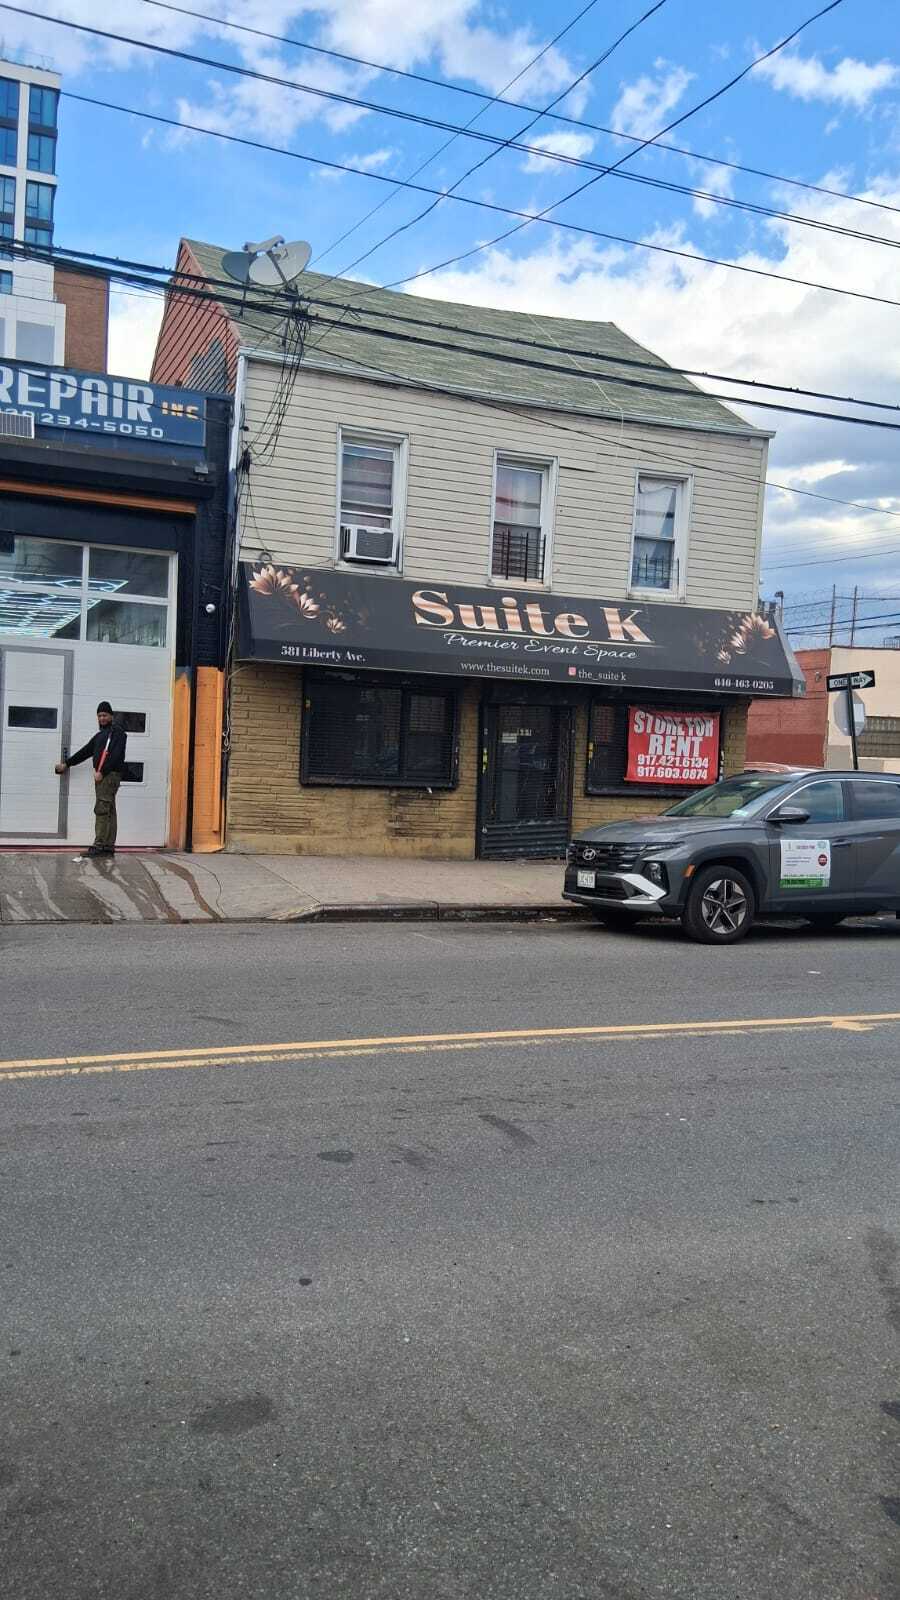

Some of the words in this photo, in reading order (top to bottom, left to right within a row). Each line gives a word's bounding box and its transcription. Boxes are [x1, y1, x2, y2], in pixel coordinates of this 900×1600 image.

[162, 401, 200, 421] INC
[411, 589, 590, 638] Suite
[600, 607, 656, 643] K
[281, 645, 300, 657] 581
[302, 647, 341, 662] Liberty
[345, 650, 366, 662] Ave.
[443, 633, 519, 651] Premier
[524, 639, 578, 655] Event
[583, 645, 639, 662] Space
[460, 661, 550, 676] www.thesuitek.com
[833, 678, 848, 687] ONE
[853, 676, 867, 684] WAY
[633, 710, 685, 736] STORE
[685, 716, 714, 737] FOR
[648, 734, 703, 758] RENT
[637, 754, 709, 768] 917.421.6134
